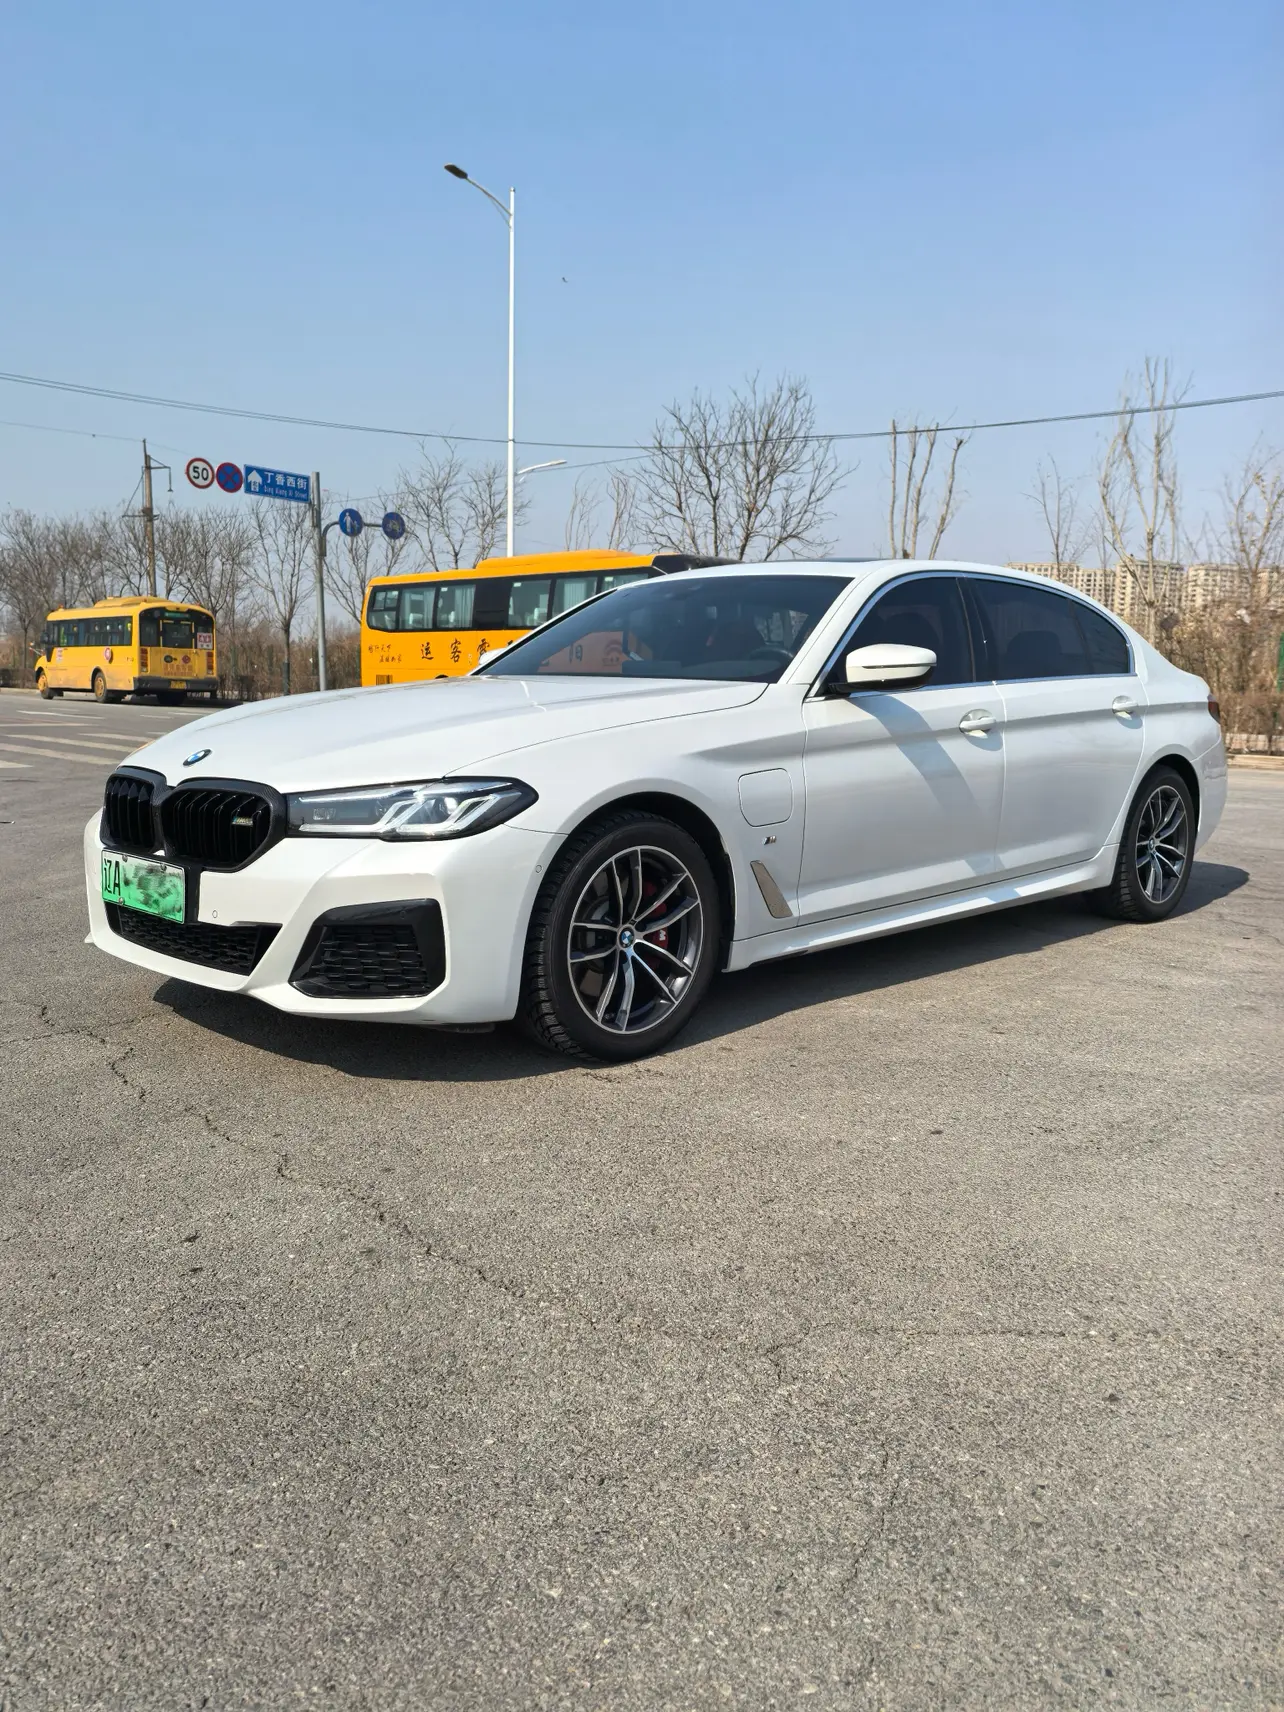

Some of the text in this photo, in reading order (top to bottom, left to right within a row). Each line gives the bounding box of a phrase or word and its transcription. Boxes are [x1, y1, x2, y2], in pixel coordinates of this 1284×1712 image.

[193, 466, 209, 481] 50
[264, 472, 307, 490] 丁香西街
